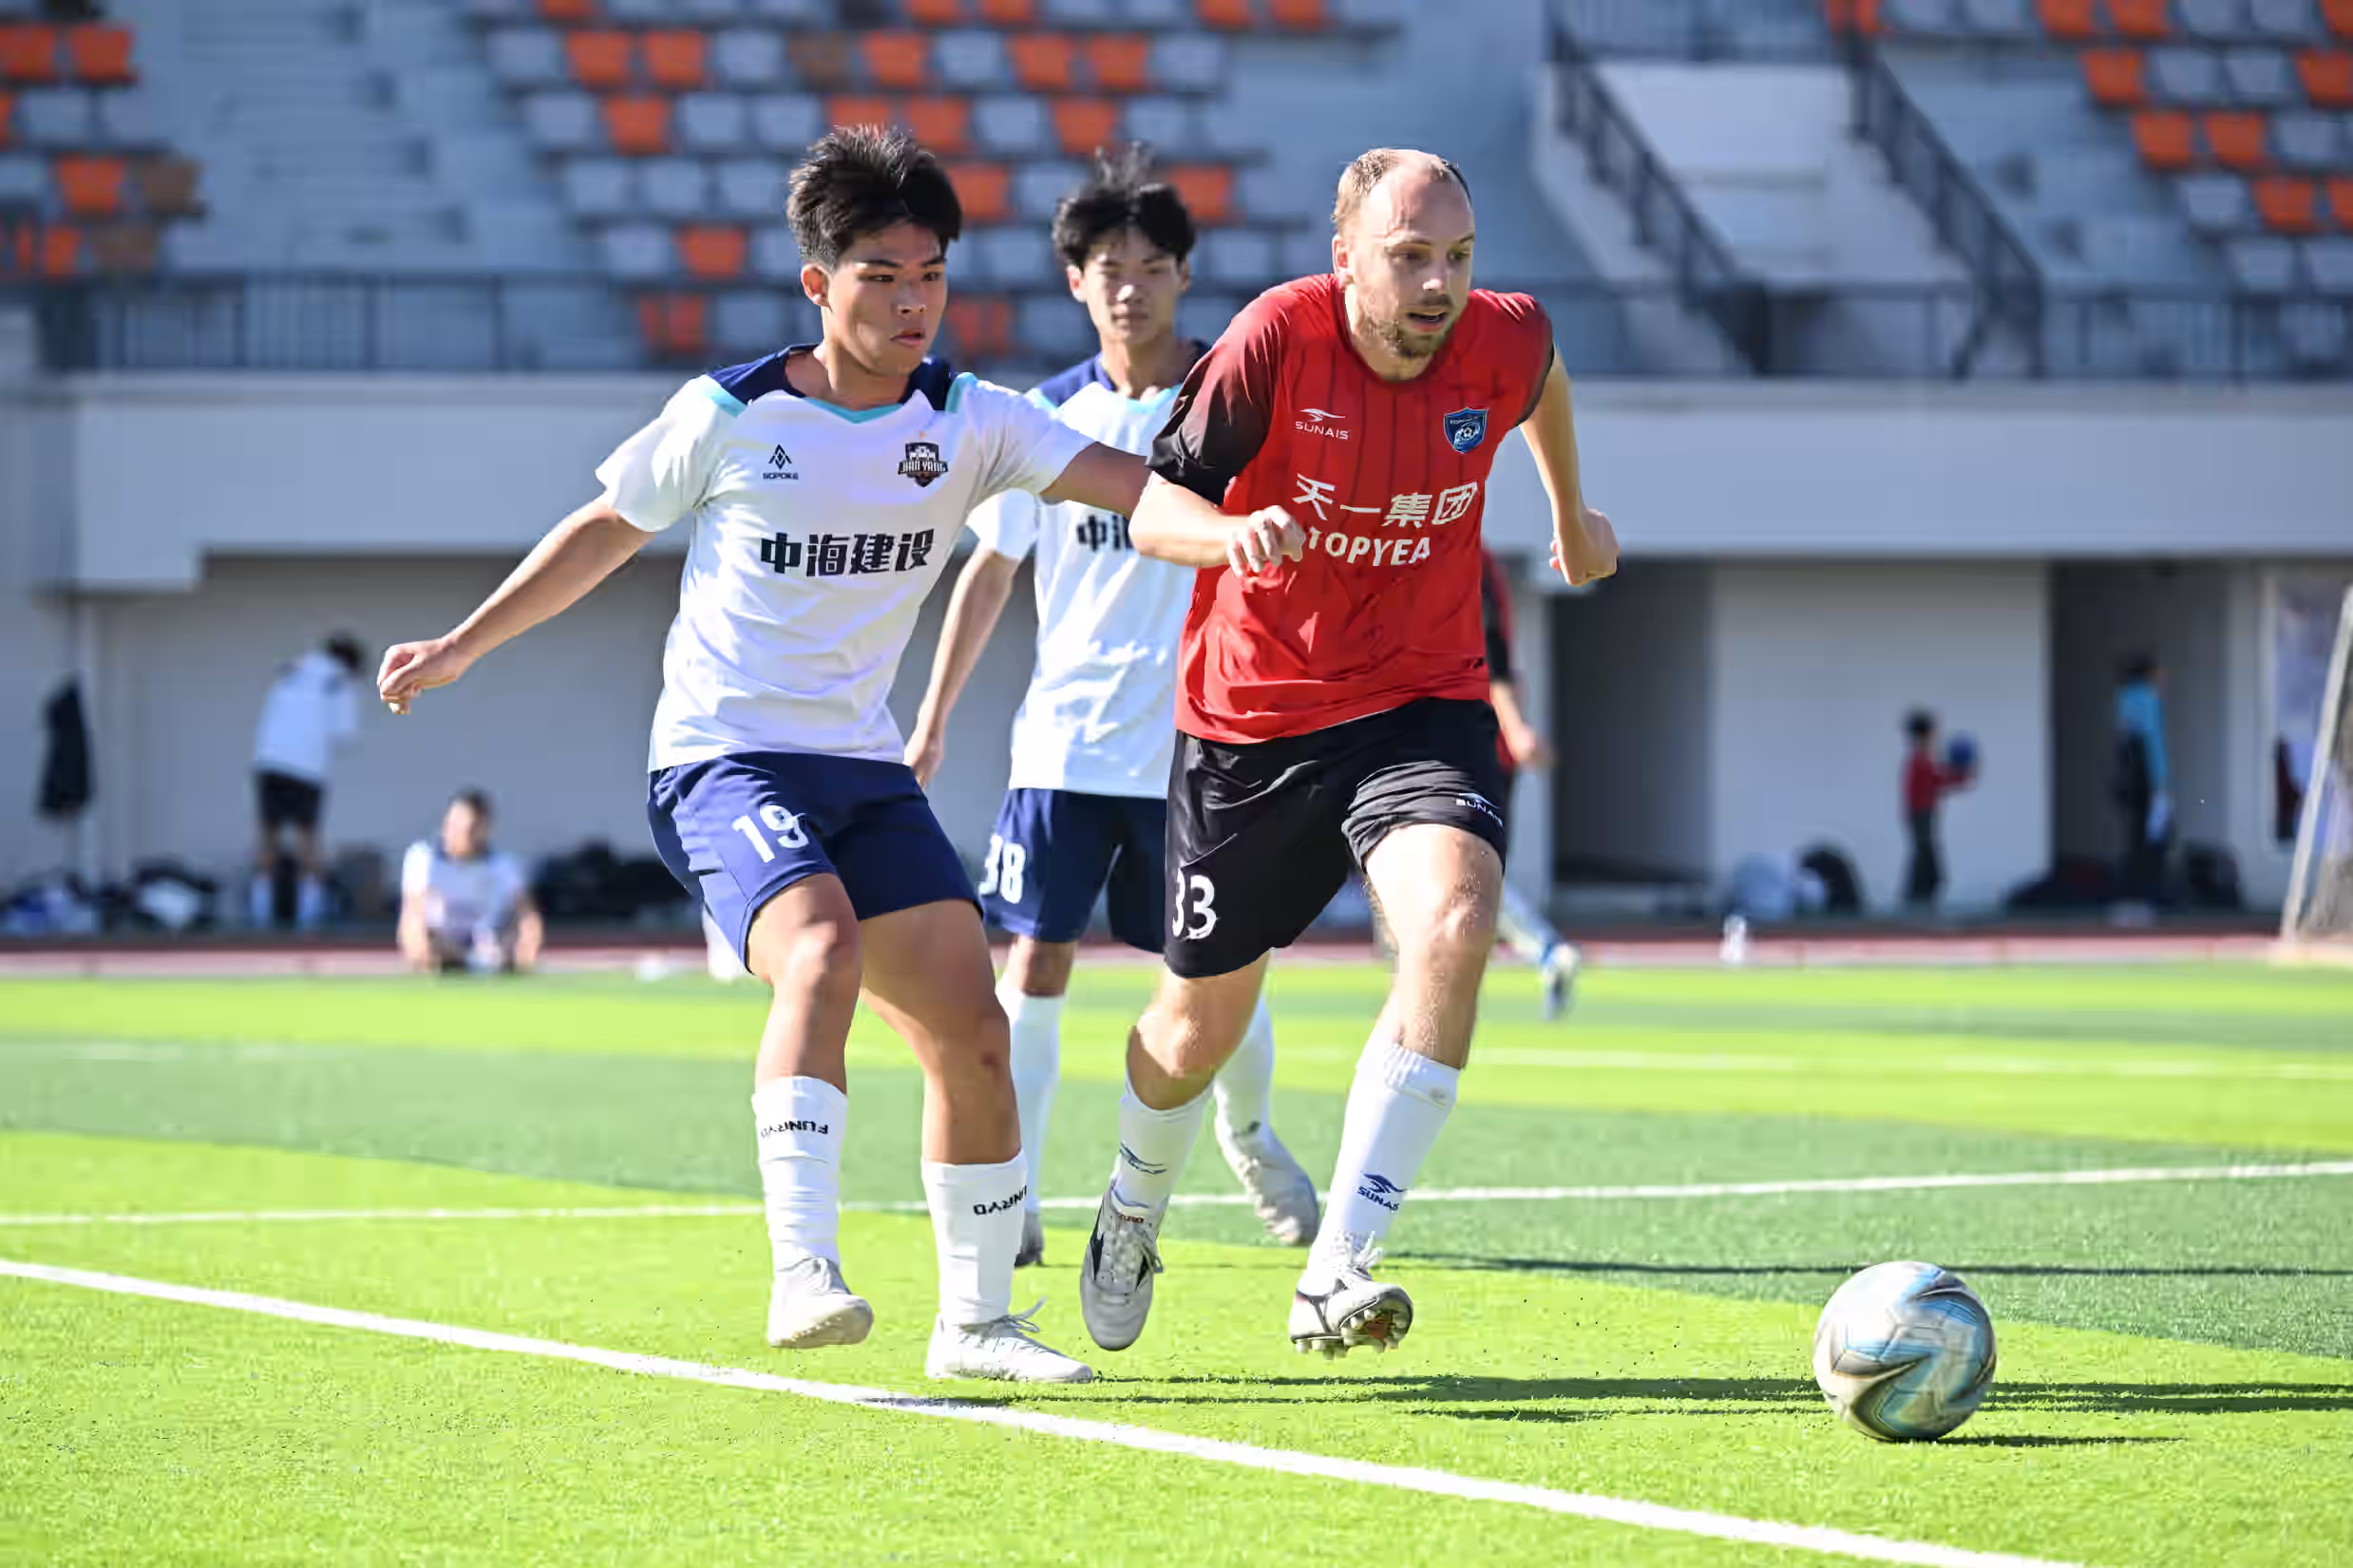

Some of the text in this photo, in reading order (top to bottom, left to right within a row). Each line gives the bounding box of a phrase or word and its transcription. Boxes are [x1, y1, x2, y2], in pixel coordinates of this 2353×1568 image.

[1295, 421, 1349, 440] SUNAIS
[1292, 472, 1478, 528] 天一集团
[761, 528, 935, 577] 中海建设
[1308, 525, 1431, 567] TOPYEA
[731, 804, 809, 862] 19
